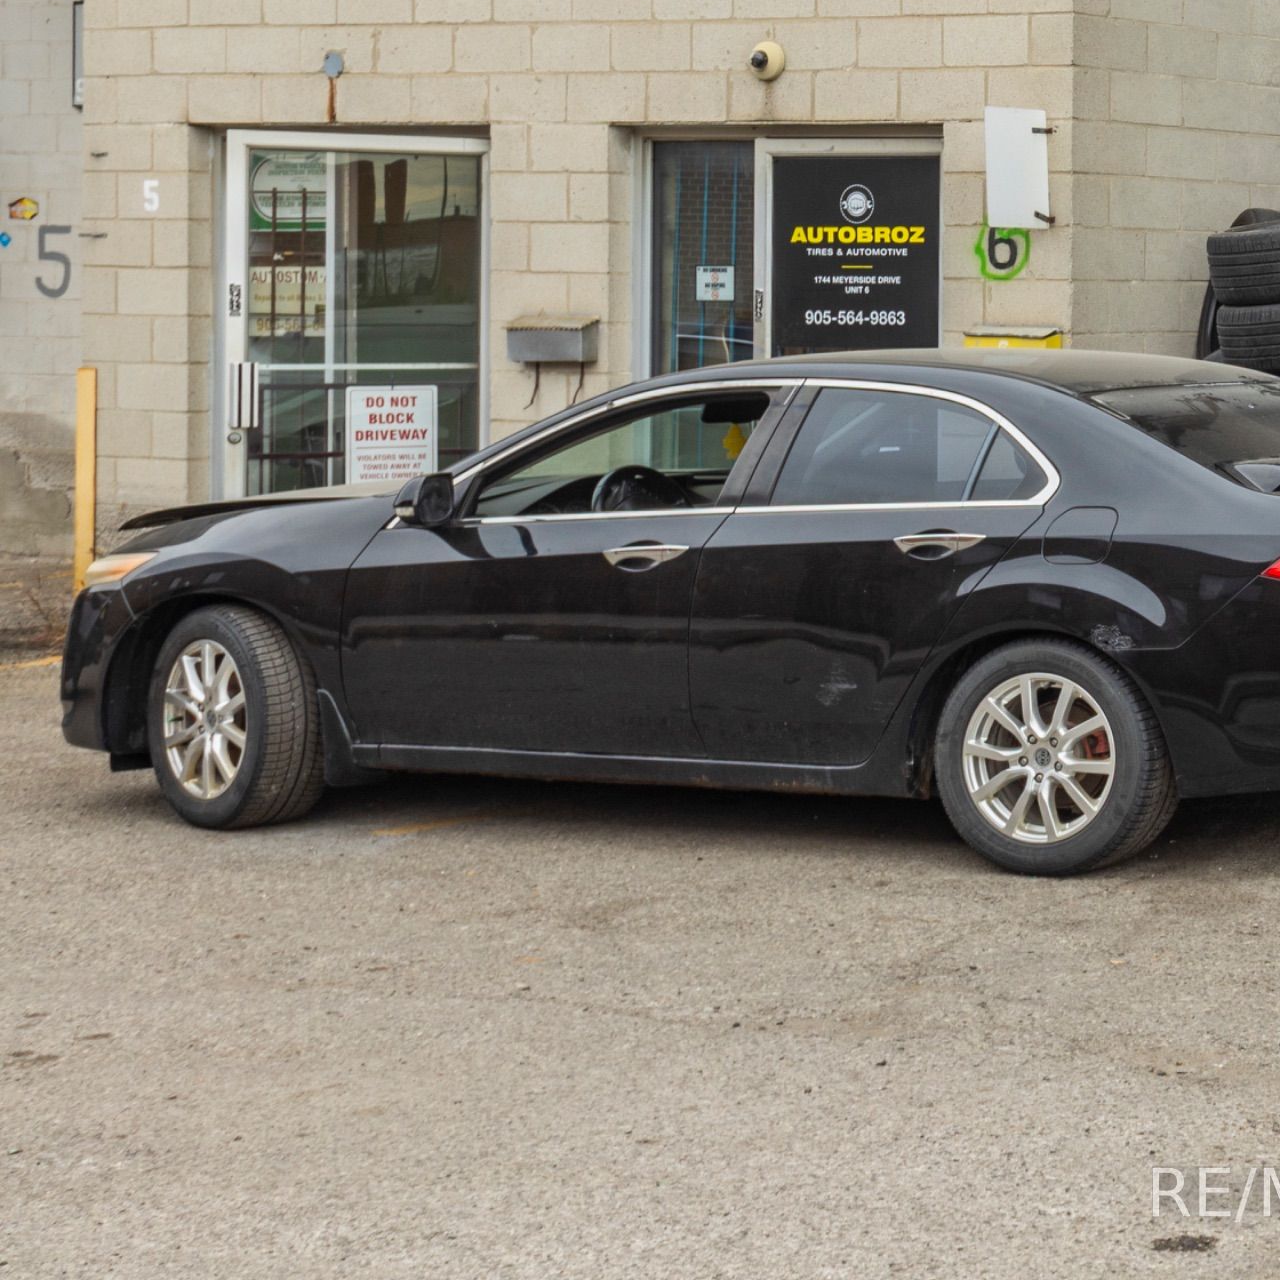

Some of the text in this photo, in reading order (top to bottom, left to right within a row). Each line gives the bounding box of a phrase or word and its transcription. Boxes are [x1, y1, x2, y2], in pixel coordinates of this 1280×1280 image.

[143, 179, 160, 212] 5
[790, 226, 925, 243] AUTOBROZ
[806, 248, 908, 256] TIRES & AUTOMOTIVE
[35, 225, 72, 298] 5
[814, 276, 901, 284] 1744 MEYERSIDE DRIVE
[844, 286, 870, 294] UNIT 6
[805, 310, 906, 325] 905-564-9863
[366, 395, 417, 408] DO NOT
[368, 412, 414, 424] BLOCK
[355, 428, 428, 442] DRIVEWAY
